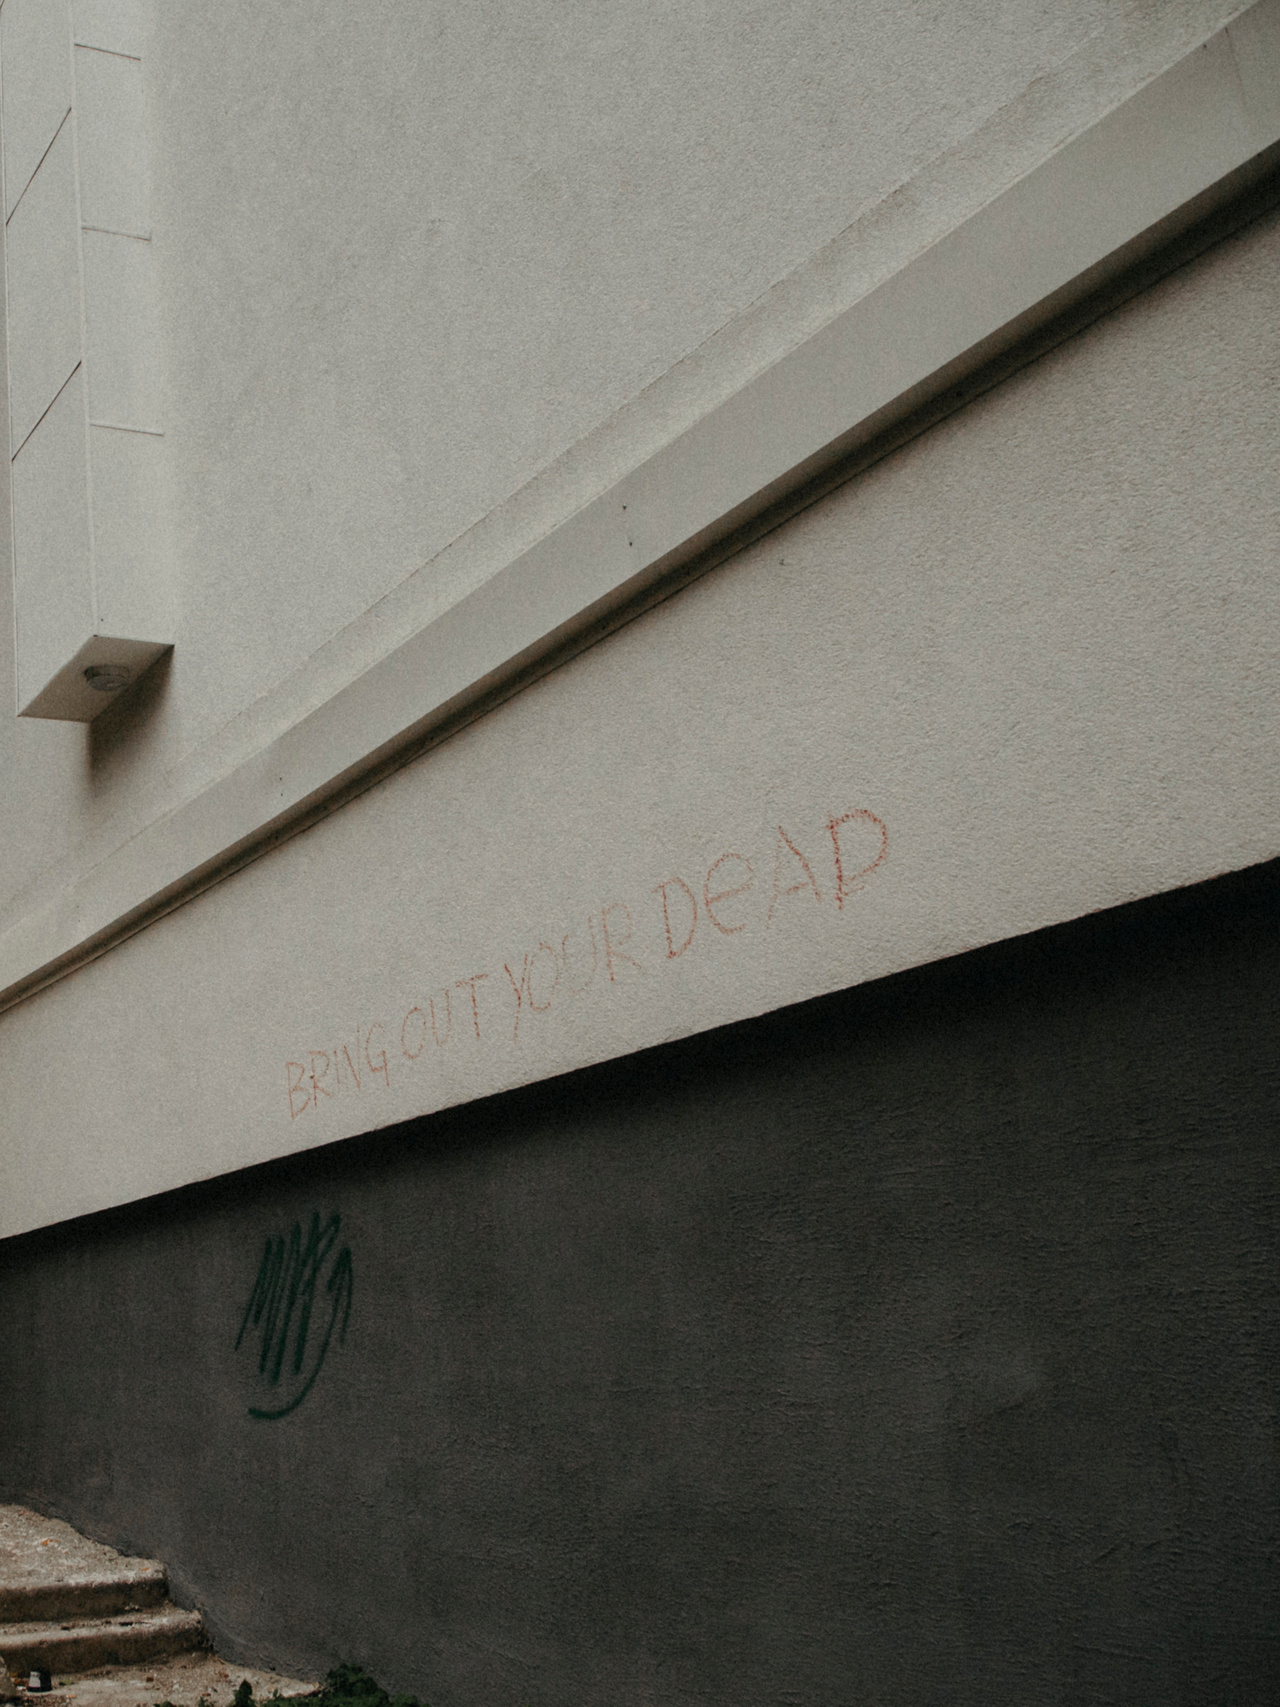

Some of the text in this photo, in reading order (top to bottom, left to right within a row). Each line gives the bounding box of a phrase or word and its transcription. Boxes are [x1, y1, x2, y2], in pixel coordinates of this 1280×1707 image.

[285, 1023, 391, 1120] BRING
[400, 973, 489, 1061] OUT
[503, 902, 643, 1045] YOUR
